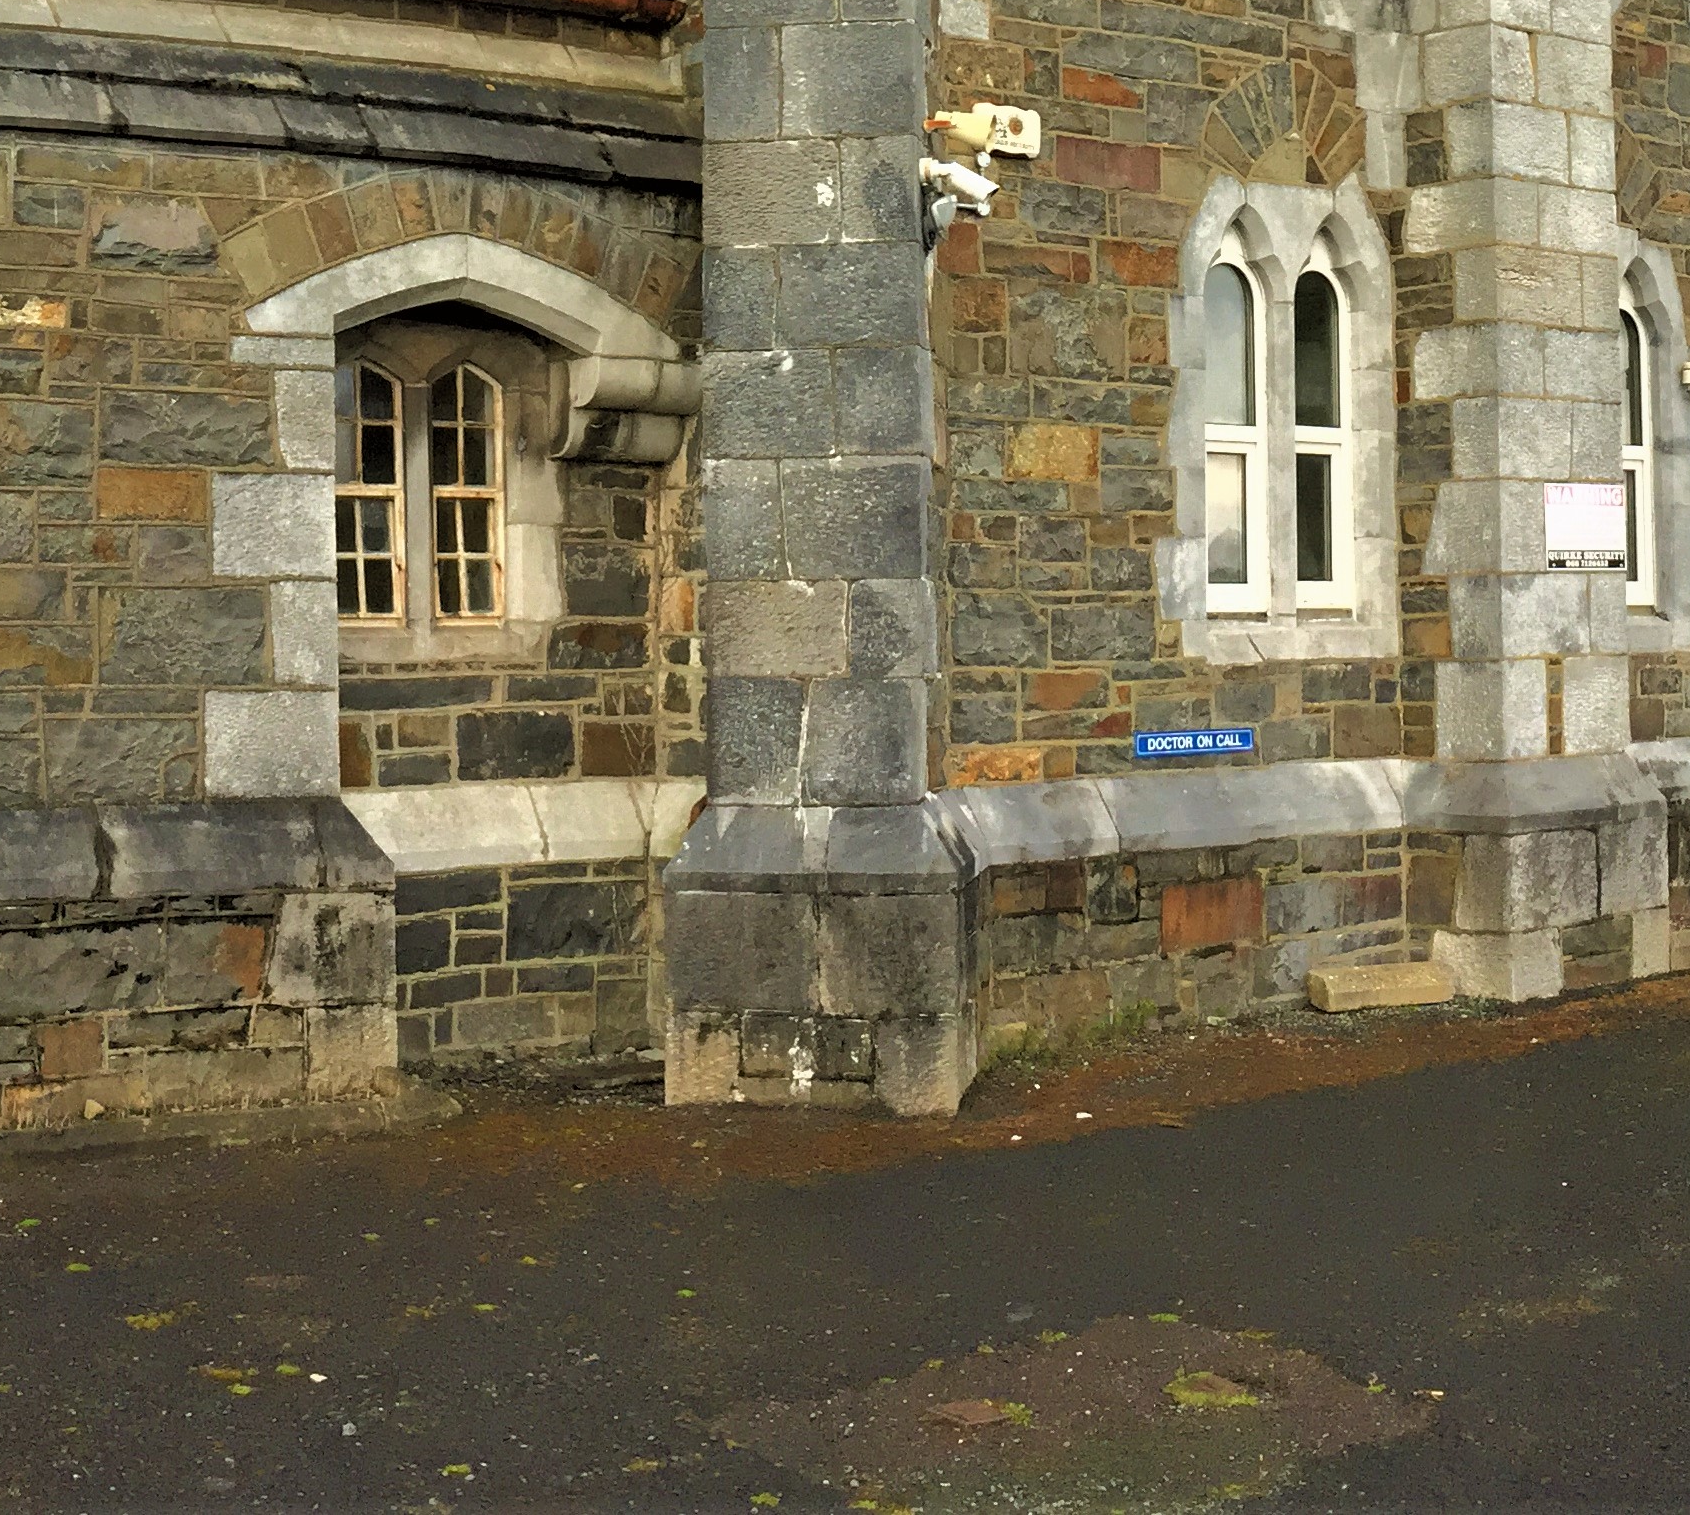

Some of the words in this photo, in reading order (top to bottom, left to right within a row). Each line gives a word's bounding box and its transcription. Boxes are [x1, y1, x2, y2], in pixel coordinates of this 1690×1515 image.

[1546, 486, 1624, 506] WAING
[1548, 551, 1582, 561] QUIRKE
[1583, 551, 1625, 561] SECURITY
[1147, 736, 1194, 751] DOCTOR
[1196, 734, 1213, 748] ON
[1215, 733, 1243, 747] CALL
